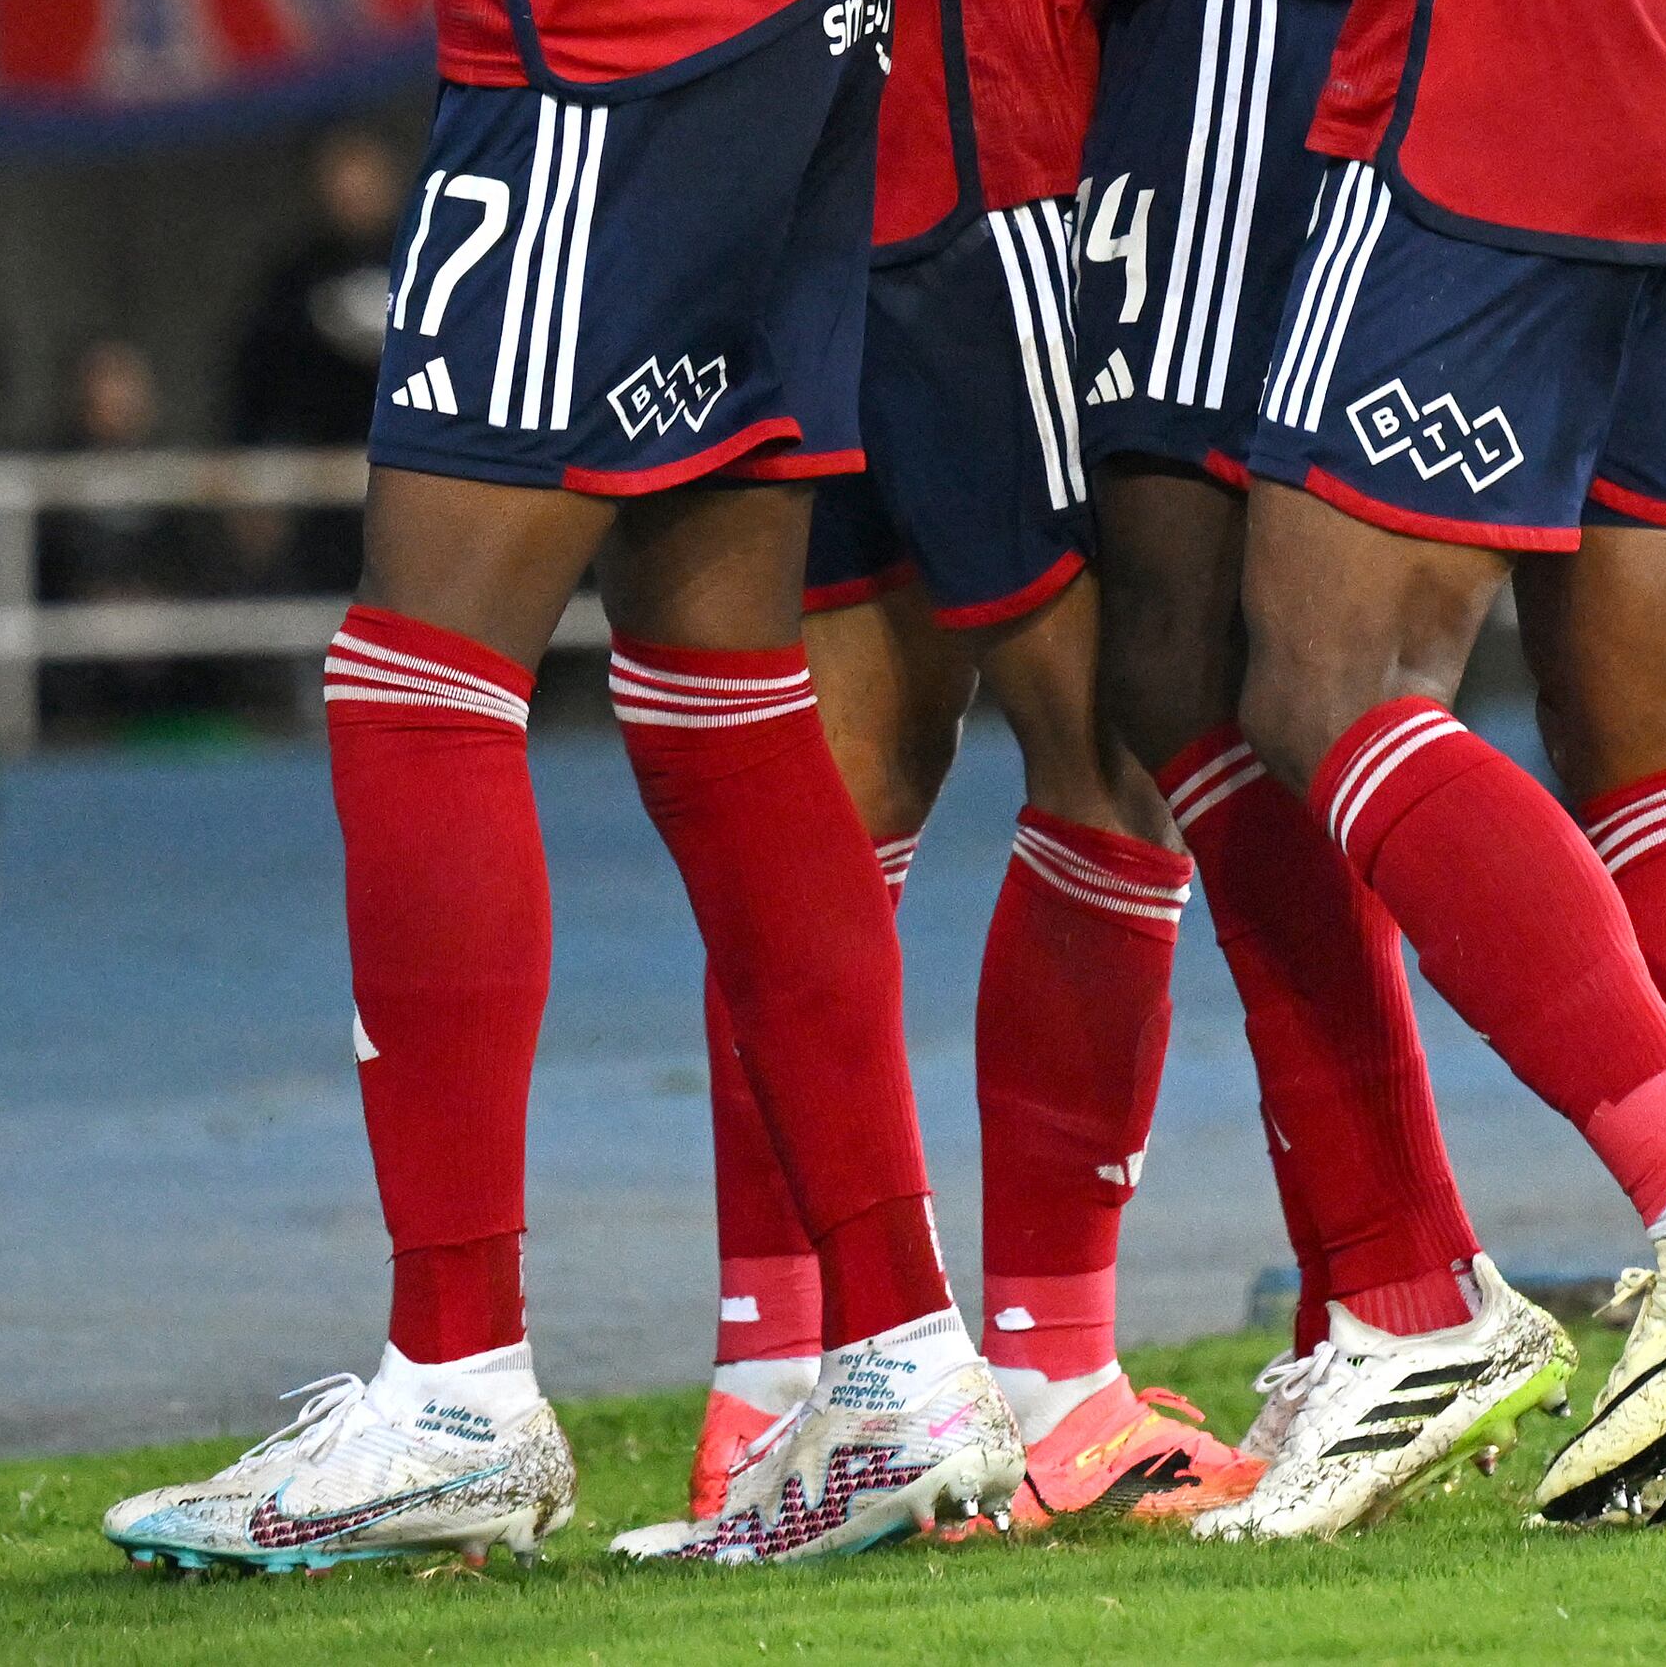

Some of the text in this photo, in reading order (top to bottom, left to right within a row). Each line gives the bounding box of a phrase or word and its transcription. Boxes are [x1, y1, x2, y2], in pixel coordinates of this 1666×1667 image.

[393, 169, 510, 337] 17
[839, 1353, 865, 1369] soy
[847, 1370, 890, 1388] estoy
[832, 1383, 895, 1400] completo
